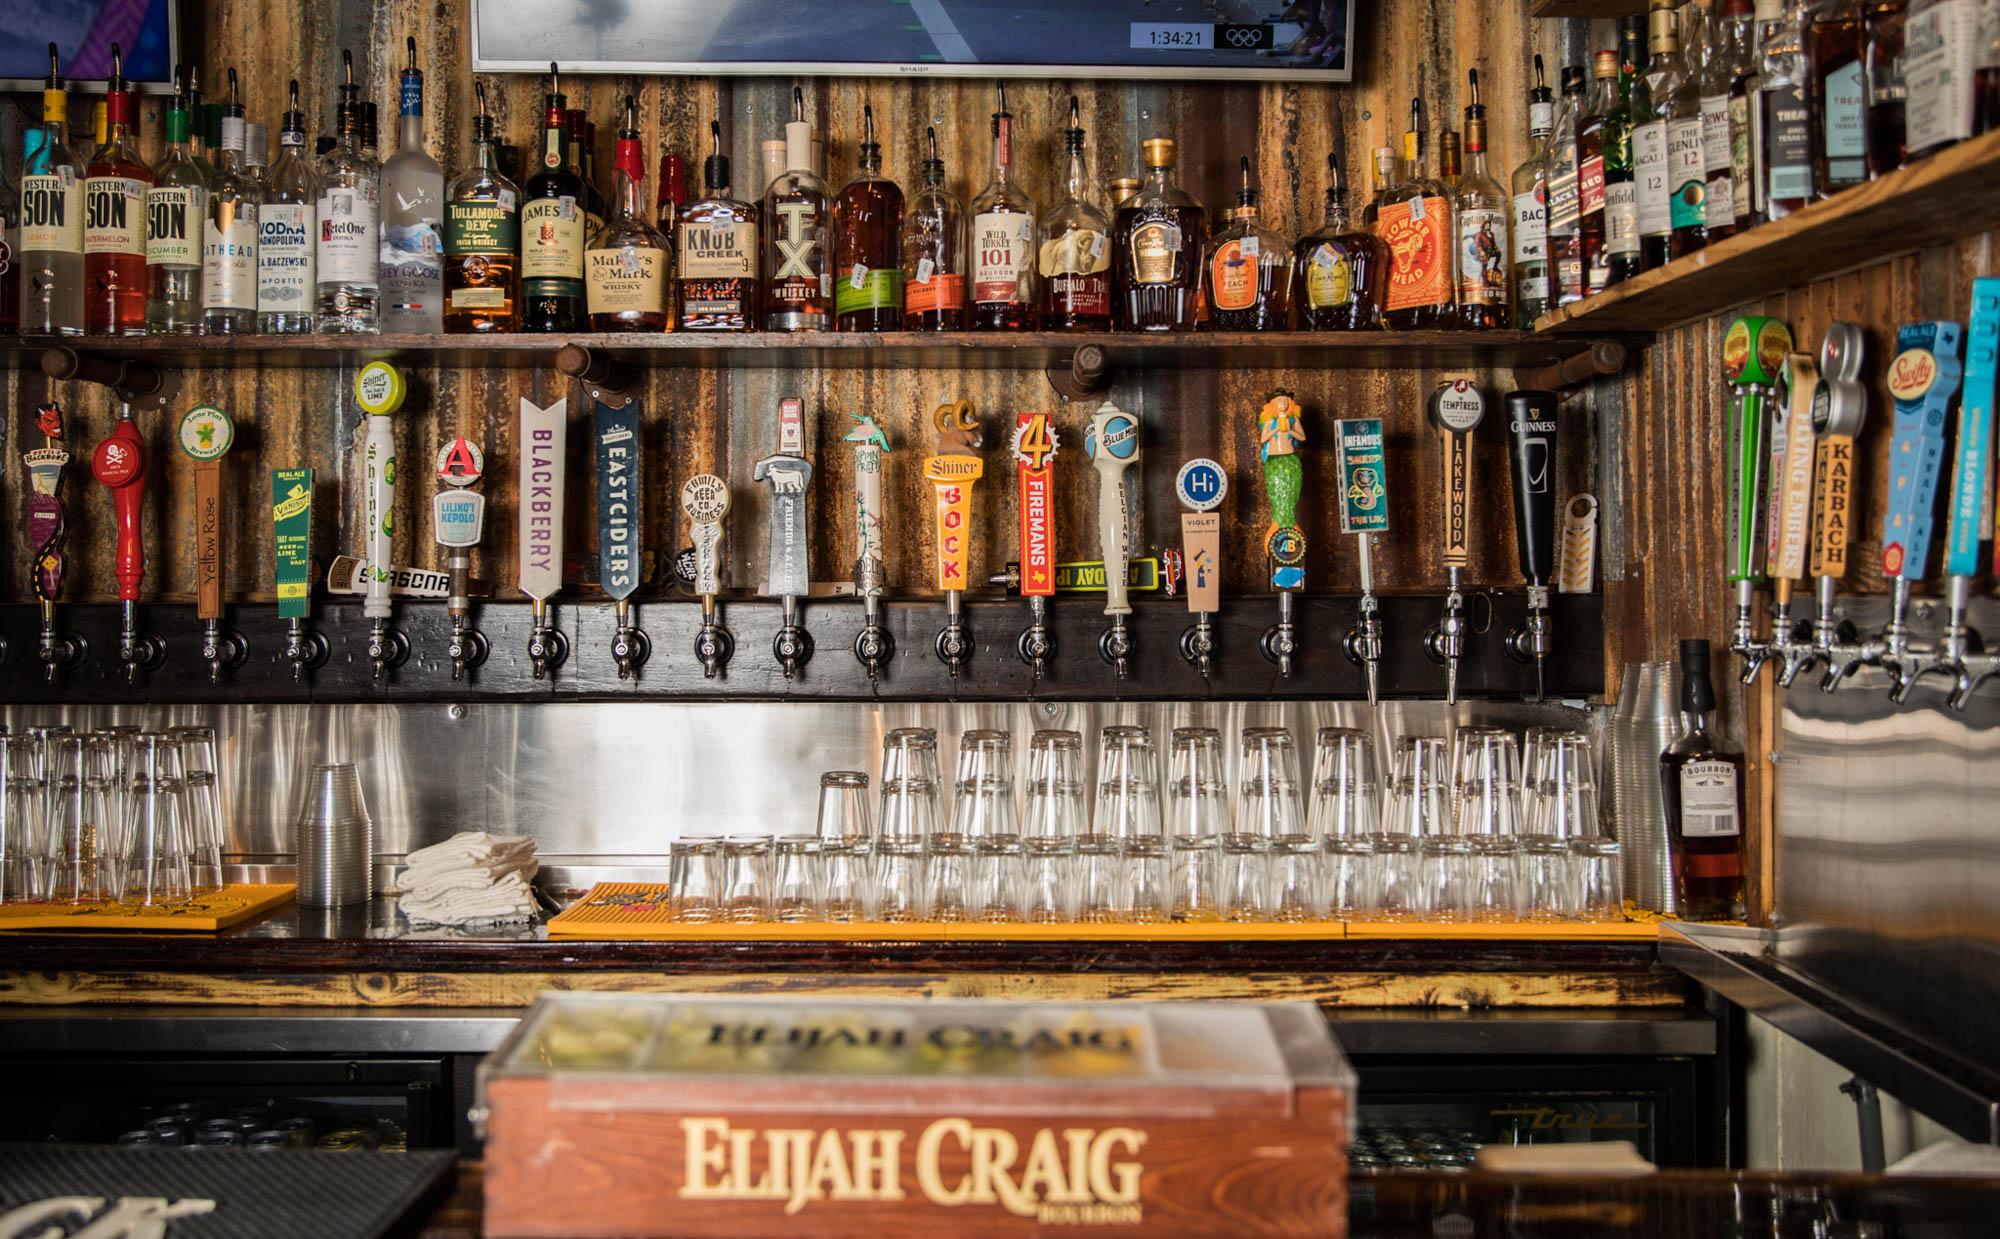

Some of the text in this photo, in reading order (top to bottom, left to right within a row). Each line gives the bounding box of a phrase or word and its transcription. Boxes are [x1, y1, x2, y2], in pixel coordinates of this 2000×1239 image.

[1149, 31, 1201, 45] 1:34:21
[1681, 129, 1698, 138] THE
[1683, 152, 1698, 165] 12
[1581, 175, 1601, 190] RED
[1647, 177, 1661, 189] 12
[23, 190, 65, 227] SON
[87, 191, 126, 229] SON
[450, 205, 506, 220] TULLAMORE
[148, 203, 186, 240] SON
[322, 219, 365, 241] Ketel One
[1385, 217, 1430, 244] HOWLER
[1611, 215, 1634, 239] 12
[27, 233, 57, 241] LEMON
[688, 229, 734, 250] KNOB
[981, 238, 1010, 248] TURKEY
[986, 230, 1006, 239] WILD
[270, 257, 307, 267] BACZEWSKI
[742, 258, 748, 272] 9
[981, 249, 1012, 267] 101
[609, 268, 652, 280] Mark
[1392, 268, 1424, 285] HEAD
[774, 287, 816, 299] WHISKEY
[1223, 280, 1248, 288] PEACH
[363, 372, 386, 388] Shiner
[1892, 356, 1932, 390] Swifty
[1442, 400, 1479, 411] TEMPTRESS
[187, 411, 222, 424] Lone Pint
[1511, 421, 1556, 433] GUINNESS
[1019, 414, 1052, 471] 4
[1103, 431, 1124, 447] BLUE
[1344, 434, 1381, 447] INFAMOUS
[190, 443, 221, 455] Brewery
[437, 435, 482, 476] A
[26, 454, 67, 463] BACKBONE
[931, 458, 978, 476] Shiner
[685, 476, 724, 494] FAMILY
[1192, 472, 1213, 492] Hi
[1453, 439, 1464, 543] LAKEWOOD
[1784, 412, 1811, 569] FLYING EMBERS
[1960, 450, 1979, 519] BLONDE
[367, 442, 377, 542] Shiner
[530, 430, 552, 572] BLACKBERRY
[694, 488, 715, 501] BEER
[685, 502, 725, 521] BUSINESS
[699, 501, 712, 509] CO.
[1118, 482, 1128, 539] BELGIAN
[1826, 443, 1849, 564] KARBACH
[1911, 448, 1935, 567] REAL ALE
[441, 513, 475, 523] KEPOLO
[608, 447, 629, 587] EASTCIDERS
[785, 499, 794, 545] FRIENDS
[1029, 481, 1046, 567] FIREMANS
[1351, 515, 1367, 525] THE
[200, 497, 215, 584] Yellow Rose
[944, 487, 961, 580] BOCK
[1280, 539, 1296, 553] AB
[1055, 567, 1105, 586] DAY IP
[1687, 765, 1730, 775] BOURBON
[678, 1116, 1146, 1216] ELIJAH CRAIG
